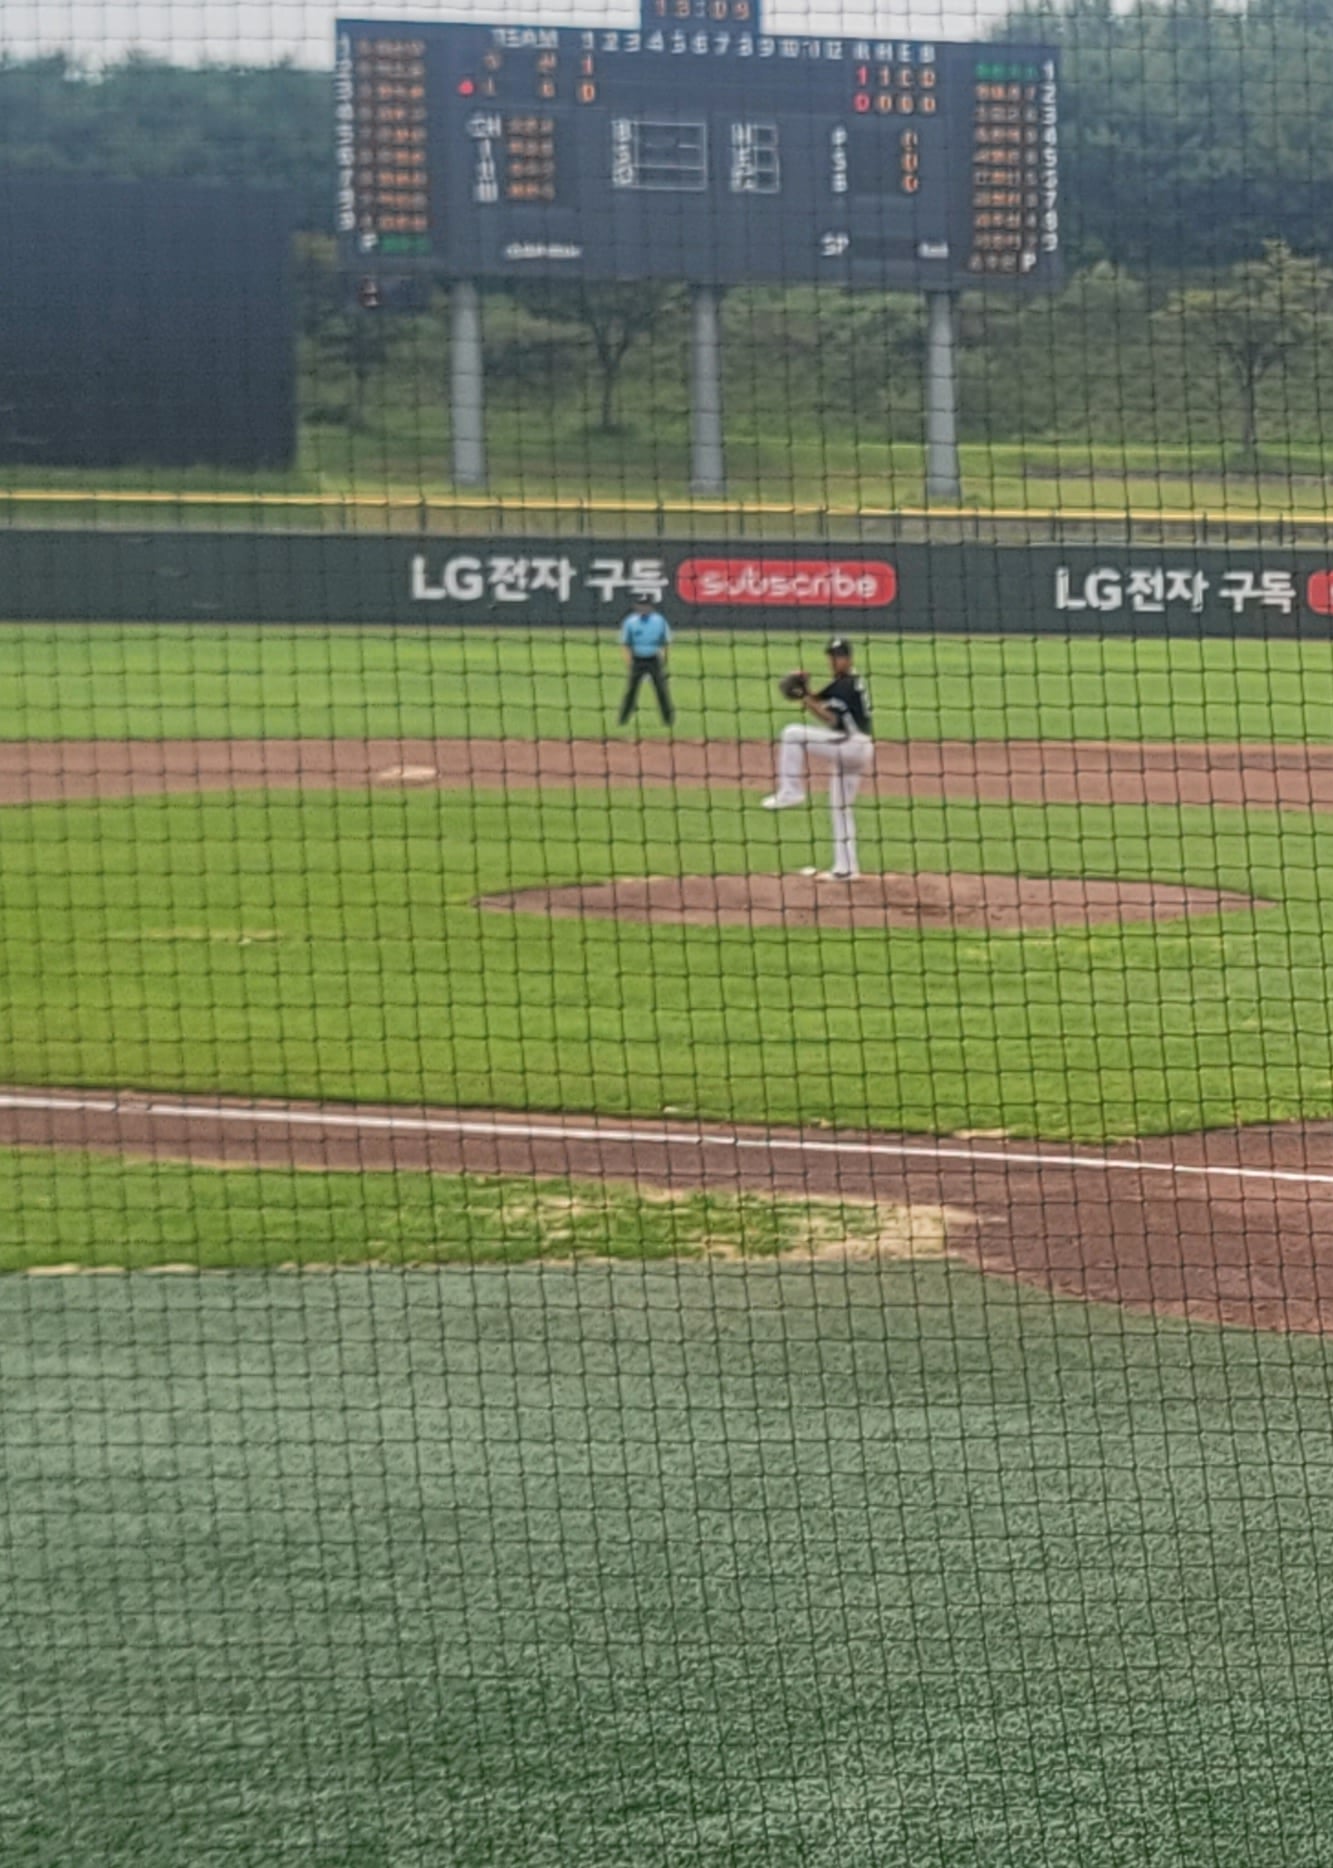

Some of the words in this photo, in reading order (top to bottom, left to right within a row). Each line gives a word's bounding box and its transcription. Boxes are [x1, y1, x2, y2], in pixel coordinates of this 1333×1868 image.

[492, 29, 557, 48] TEAM
[854, 94, 871, 114] 0
[411, 558, 576, 601] LG전자
[586, 563, 669, 602] 구독
[699, 569, 878, 598] subscribe
[1055, 568, 1208, 612] LG전자
[1219, 570, 1295, 613] 구독
